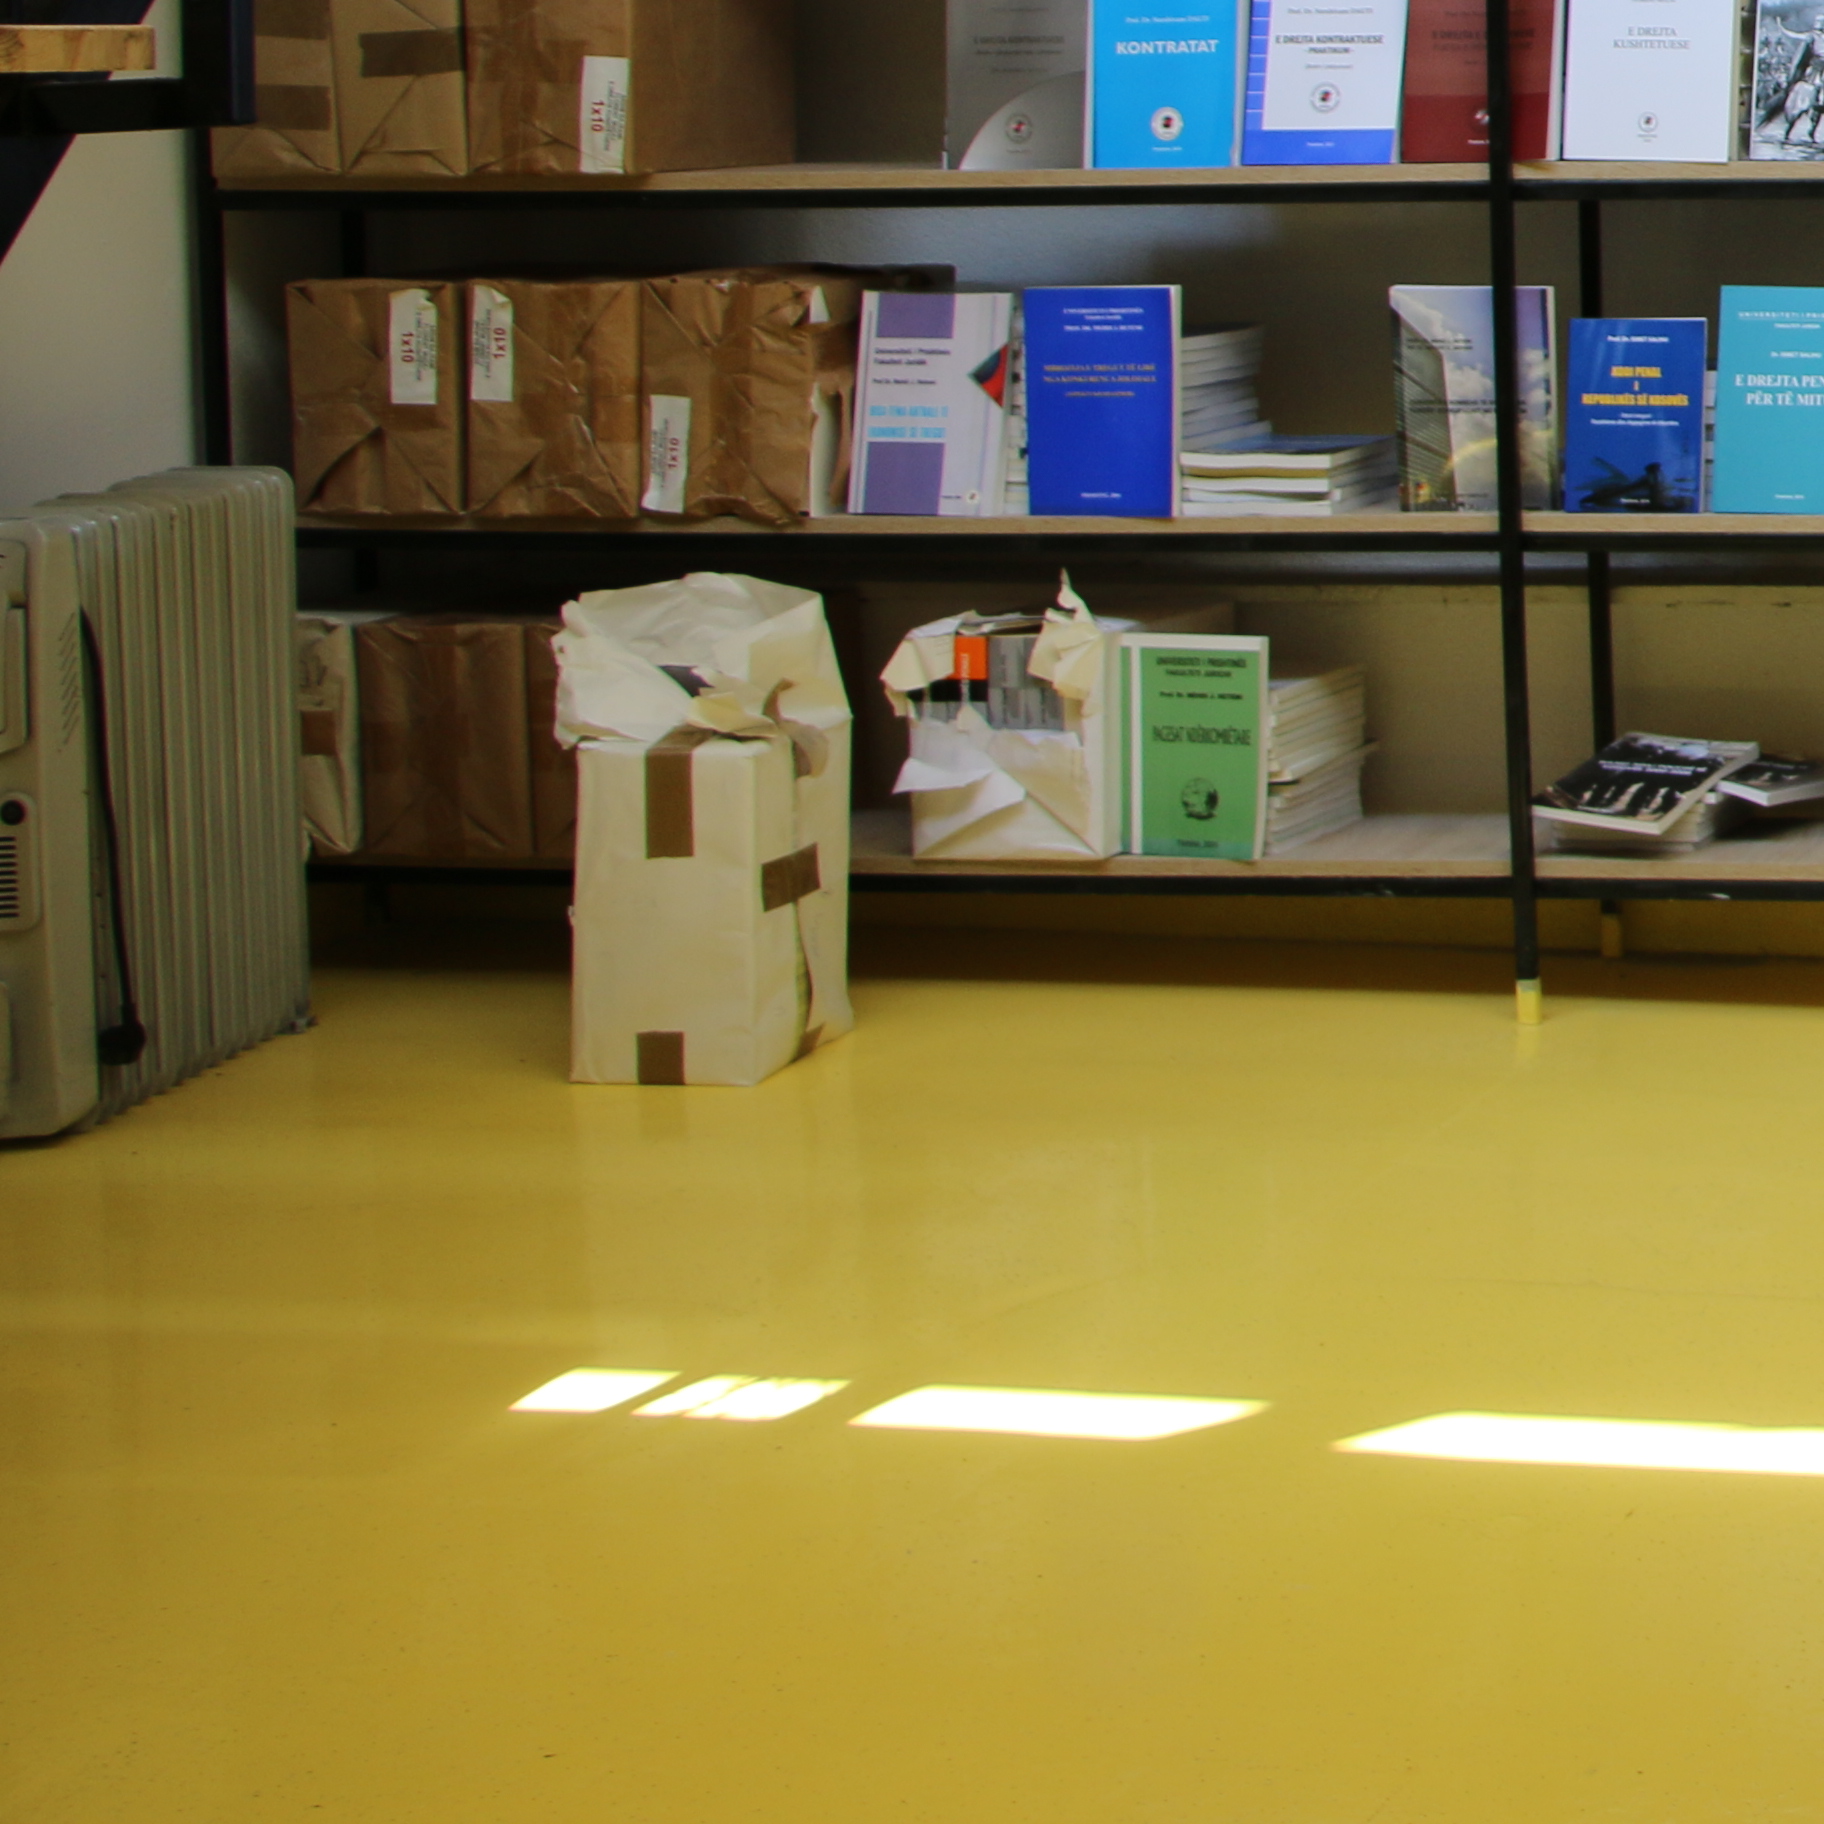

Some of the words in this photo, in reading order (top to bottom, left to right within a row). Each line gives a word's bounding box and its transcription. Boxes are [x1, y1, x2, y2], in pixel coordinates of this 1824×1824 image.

[1283, 33, 1311, 44] DREJTA
[1316, 33, 1384, 44] KONTRAKTUESE
[1637, 26, 1677, 37] DREJTA
[1116, 39, 1218, 55] KONTRATAT
[1613, 39, 1691, 50] KUSHTETUESE
[401, 330, 415, 363] 1x10
[493, 327, 507, 359] 1x10
[1747, 375, 1798, 389] DREJTA
[1747, 391, 1775, 407] PËR
[1778, 391, 1796, 407] TË
[667, 437, 680, 469] 1x10
